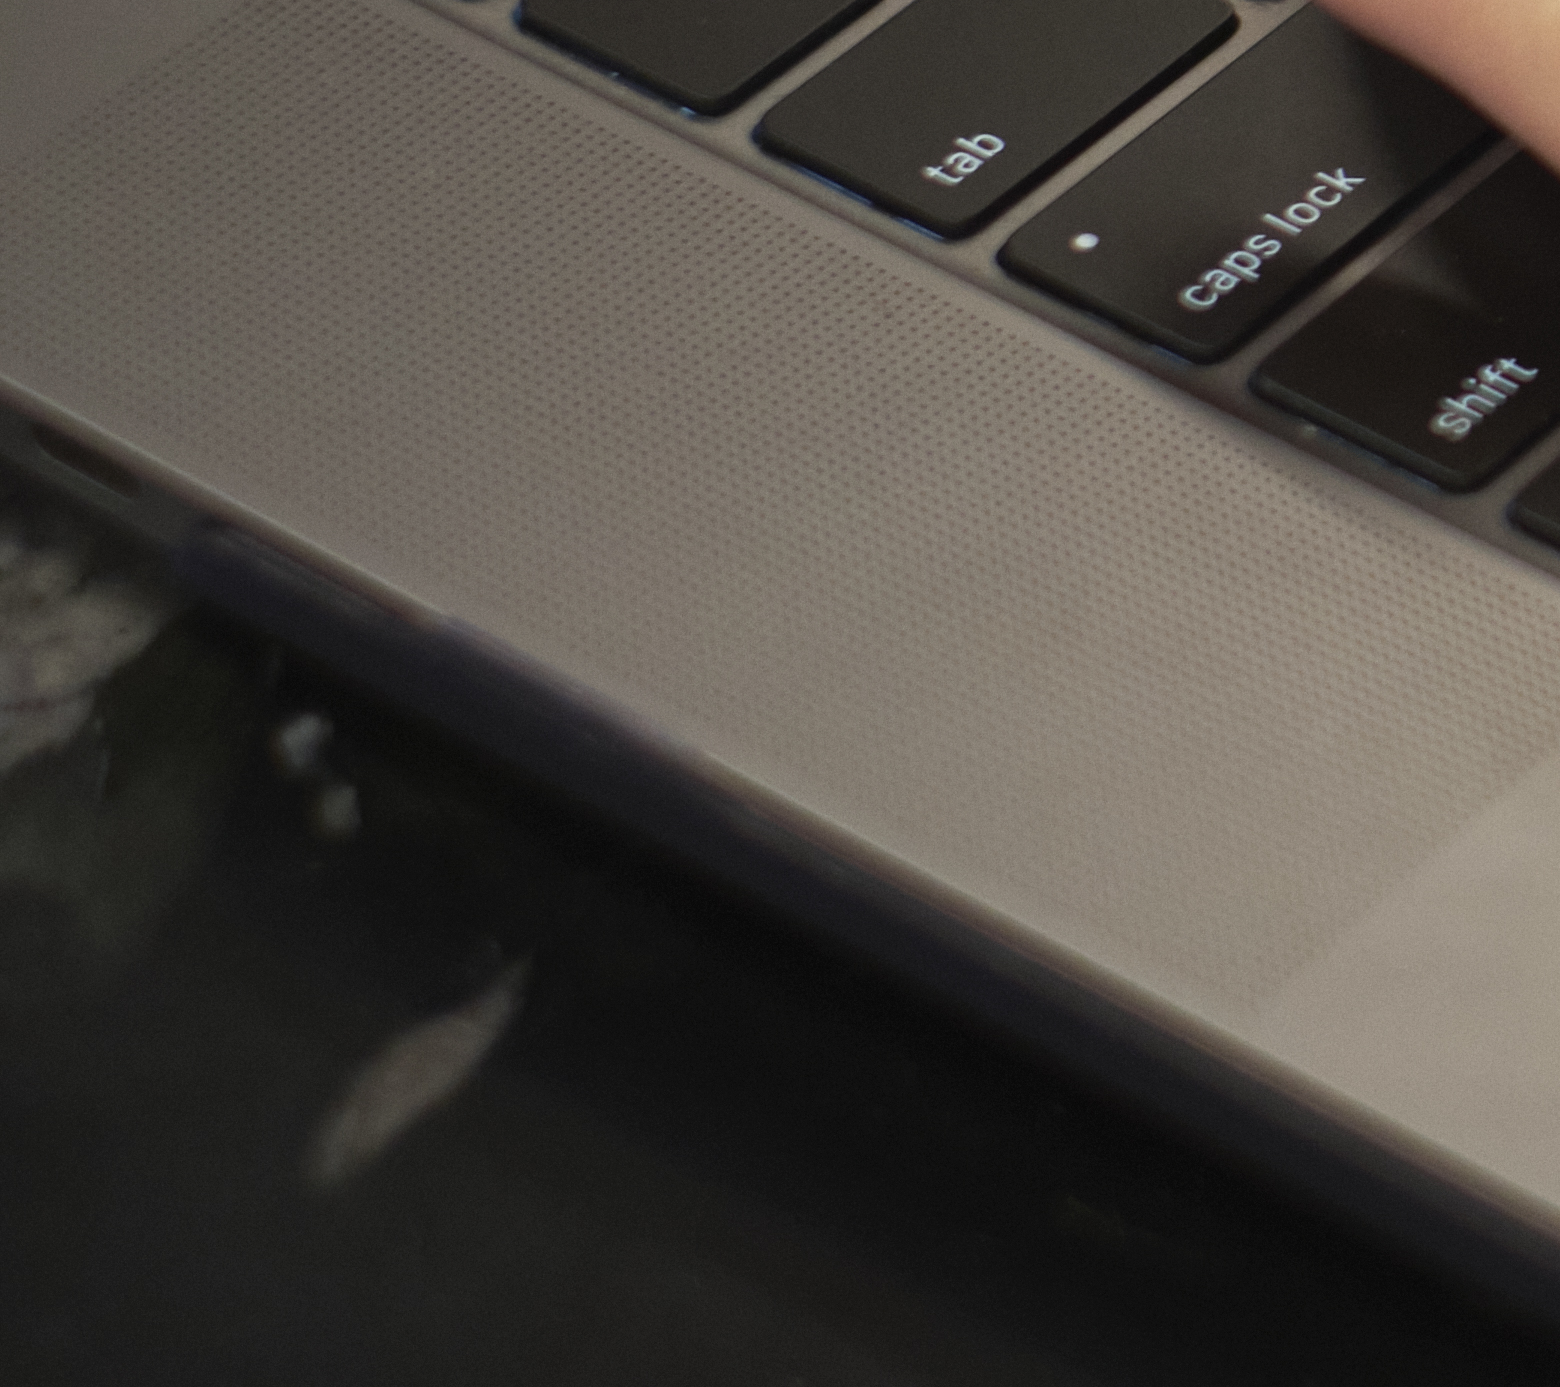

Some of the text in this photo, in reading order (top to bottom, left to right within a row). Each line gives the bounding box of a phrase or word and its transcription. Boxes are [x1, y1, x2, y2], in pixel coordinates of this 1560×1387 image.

[922, 132, 1006, 187] tab
[1179, 167, 1367, 312] caps lock
[1430, 357, 1539, 443] shift
